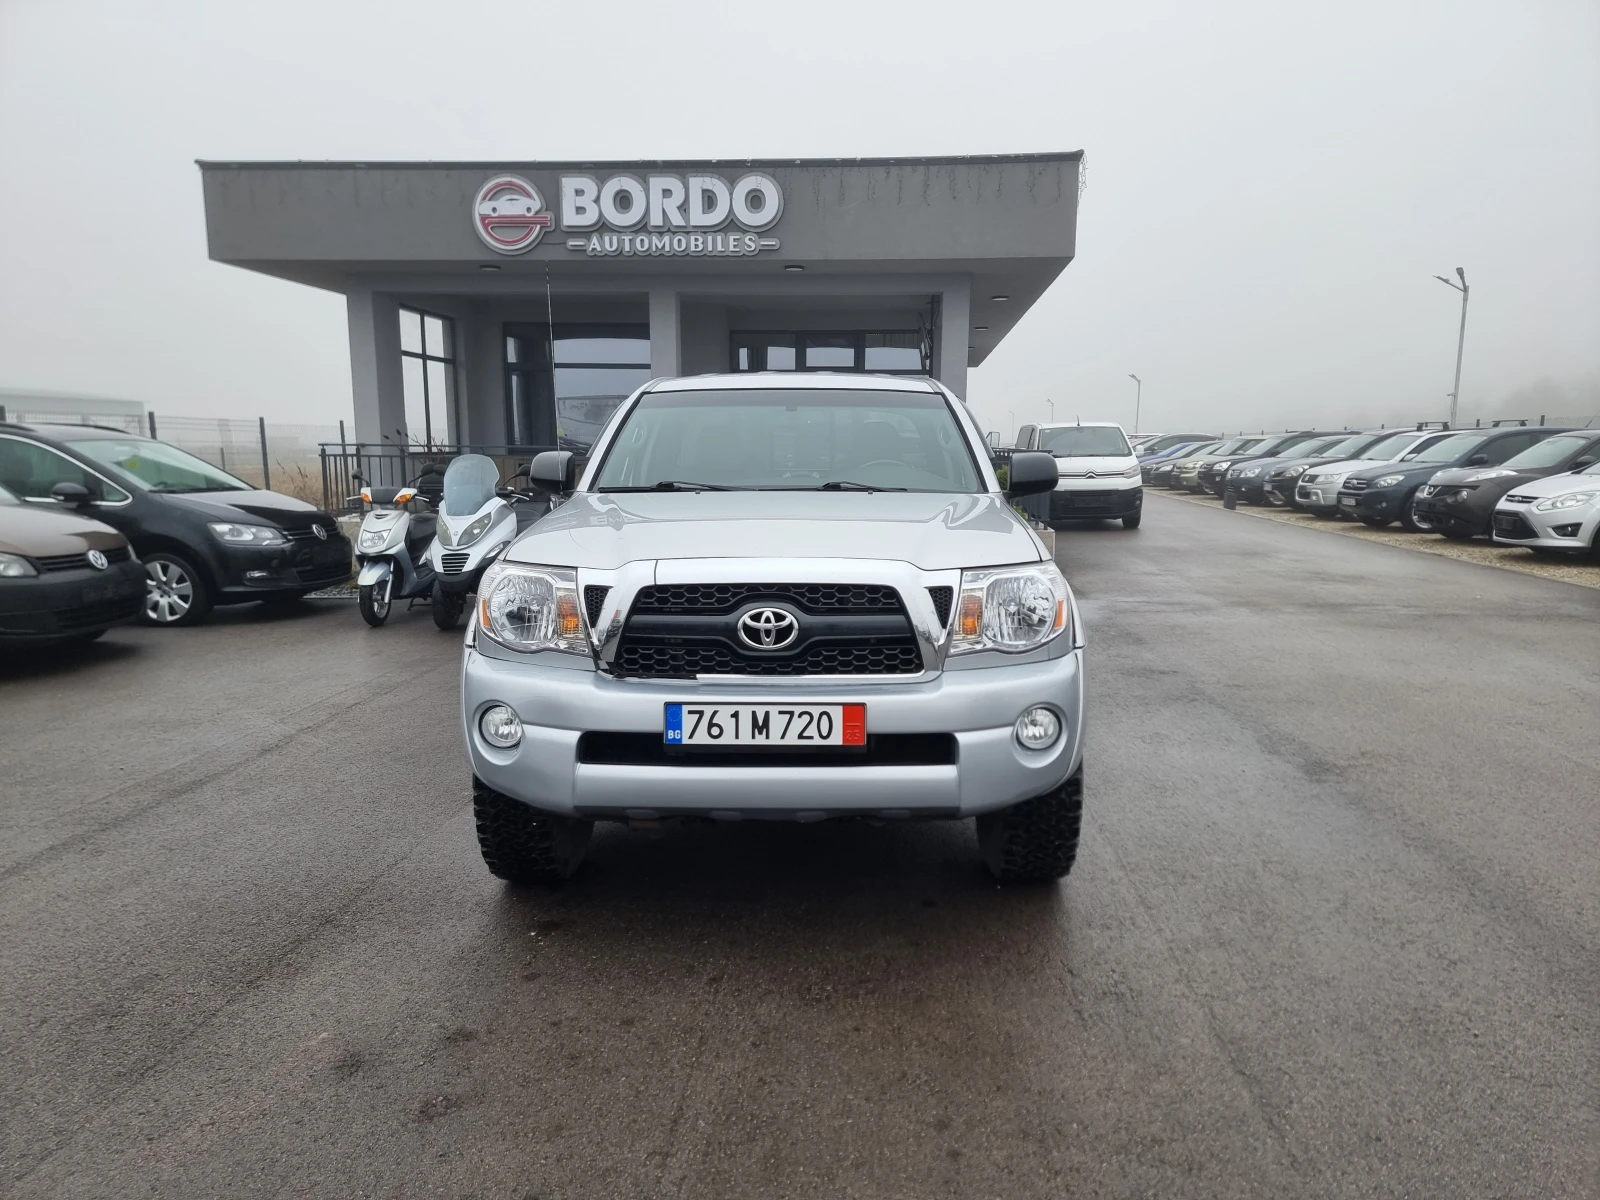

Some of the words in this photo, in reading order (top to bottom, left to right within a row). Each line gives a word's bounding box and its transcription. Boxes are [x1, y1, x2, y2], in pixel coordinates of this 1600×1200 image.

[561, 175, 780, 227] BORDO
[588, 235, 757, 252] AUTOMOBILES
[667, 730, 681, 740] BG
